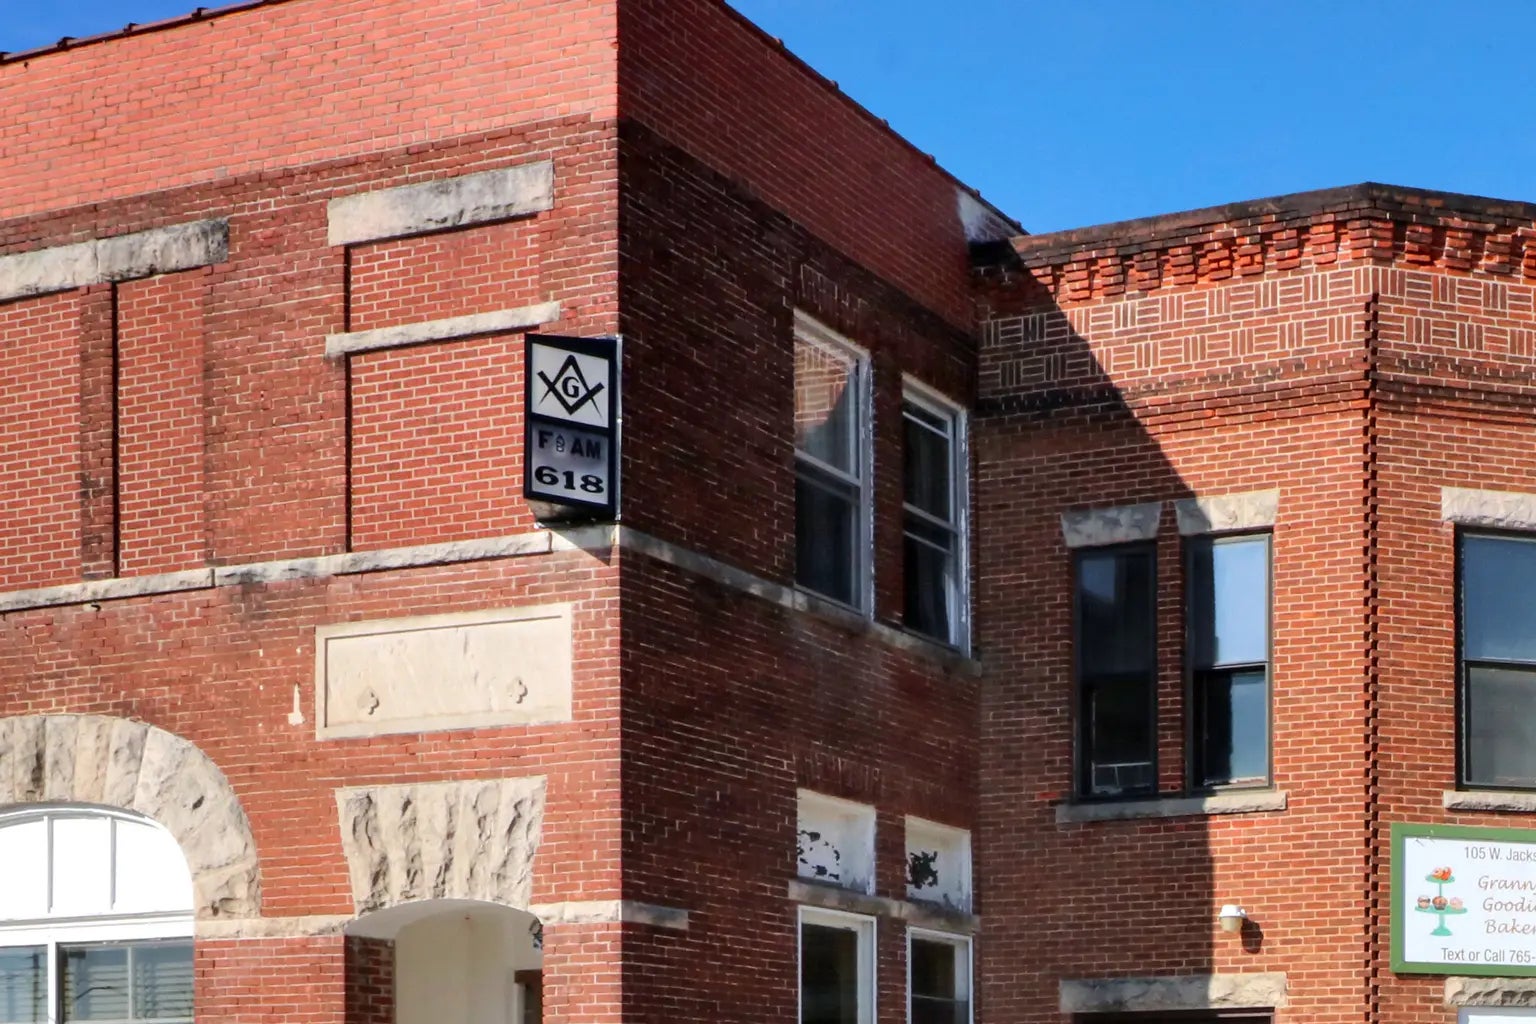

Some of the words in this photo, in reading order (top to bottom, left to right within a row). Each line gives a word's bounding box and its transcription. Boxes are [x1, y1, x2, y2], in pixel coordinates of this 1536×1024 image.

[562, 376, 580, 398] G
[538, 430, 553, 449] F
[570, 438, 600, 459] AM
[534, 465, 605, 494] 618
[1464, 846, 1486, 860] 105
[1489, 847, 1502, 860] W.
[1441, 947, 1464, 961] Text
[1468, 950, 1480, 961] or
[1484, 949, 1505, 962] Call
